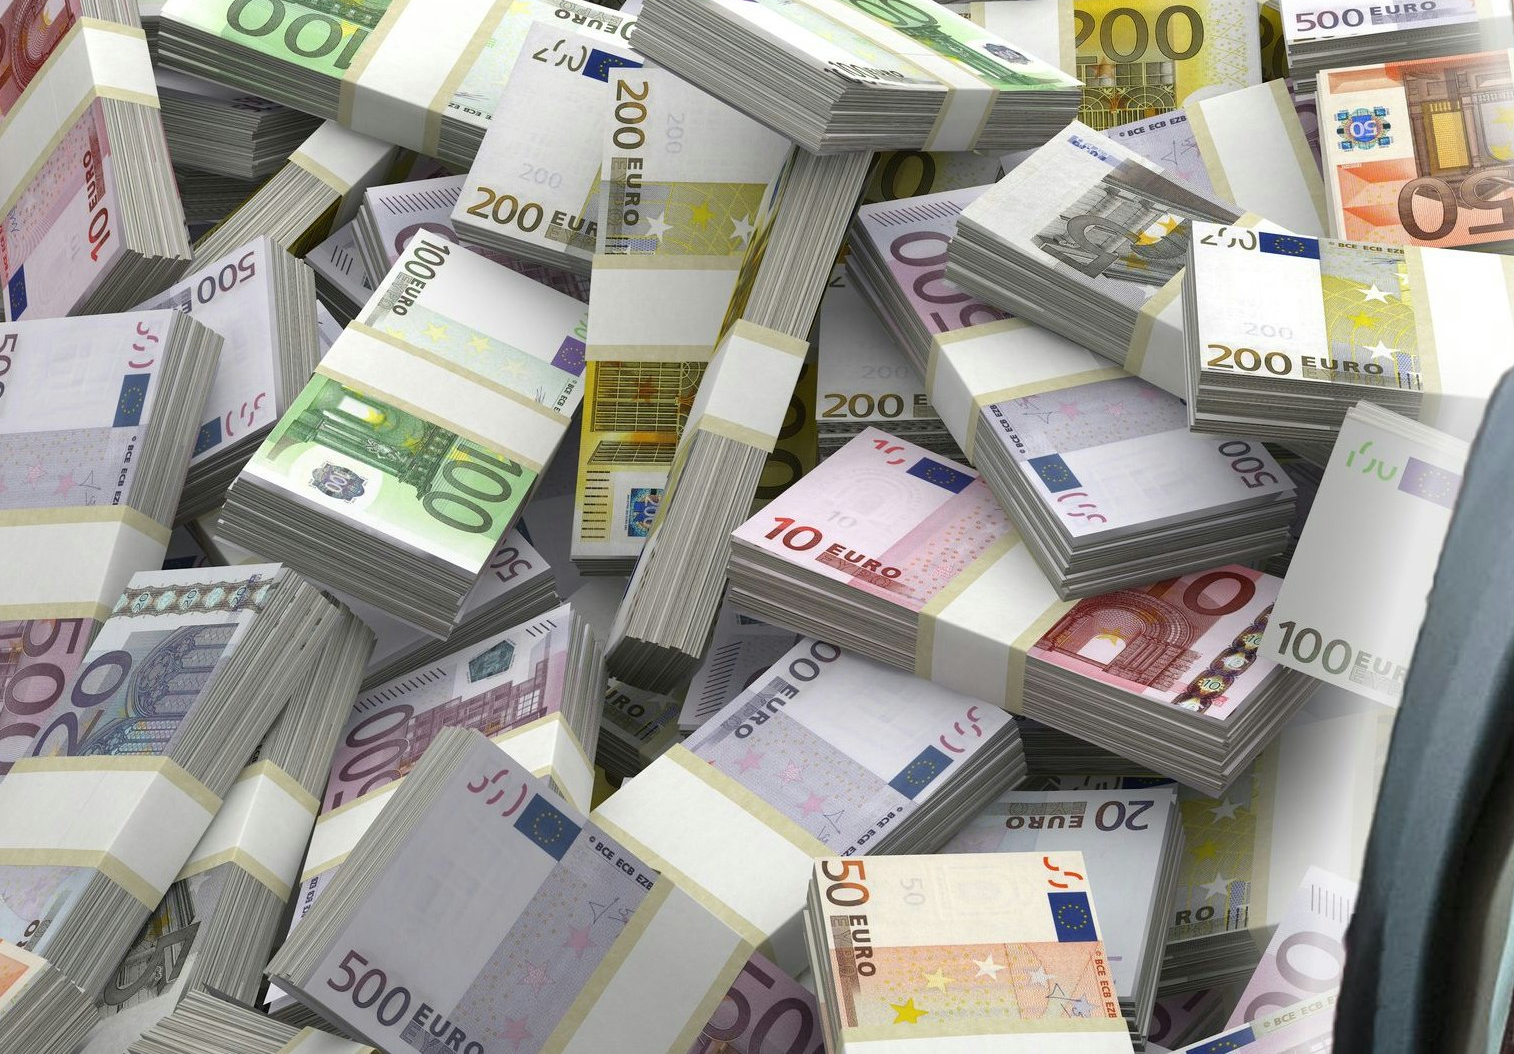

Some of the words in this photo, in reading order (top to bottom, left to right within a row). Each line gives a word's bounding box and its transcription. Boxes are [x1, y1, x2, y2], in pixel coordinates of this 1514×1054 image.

[554, 8, 617, 35] EURO
[1295, 8, 1365, 32] 500
[1369, 0, 1438, 16] EURO
[612, 80, 650, 150] 200
[1127, 126, 1146, 138] BCE
[1148, 120, 1167, 132] ECB
[1169, 115, 1187, 127] EZB
[1349, 118, 1378, 135] 50
[82, 151, 104, 212] EURO
[626, 157, 644, 227] EURO
[466, 186, 544, 233] 200
[89, 207, 112, 262] 10
[1338, 242, 1357, 250] BCE
[1363, 244, 1383, 252] ECB
[1387, 247, 1405, 255] EZB
[410, 240, 451, 281] 100
[197, 251, 257, 305] 500
[392, 276, 428, 317] EURO
[1206, 344, 1294, 378] 200
[1300, 355, 1385, 376] EURO
[563, 383, 575, 395] BCE
[821, 393, 905, 419] 200
[989, 404, 1003, 418] EZB
[999, 419, 1013, 433] ECB
[124, 444, 134, 464] BCE
[1009, 434, 1024, 449] BCE
[118, 467, 128, 487] ECB
[1217, 439, 1280, 489] 500
[325, 469, 349, 493] 100
[422, 445, 523, 534] 100
[762, 516, 824, 553] 10
[827, 542, 902, 580] EURO
[1277, 621, 1352, 676] 100
[1202, 678, 1222, 692] 10
[734, 683, 800, 740] EURO
[876, 811, 896, 829] BCE
[1005, 815, 1084, 830] EURO
[1095, 800, 1155, 832] 20
[857, 828, 876, 846] ECB
[595, 841, 615, 861] BCE
[616, 858, 635, 877] ECB
[821, 859, 871, 908] 50
[848, 914, 876, 978] EURO
[1095, 958, 1106, 977] BCE
[327, 949, 411, 1028] 500
[407, 1002, 484, 1054] EURO
[1100, 980, 1111, 998] ECB
[1105, 1001, 1117, 1017] EZB
